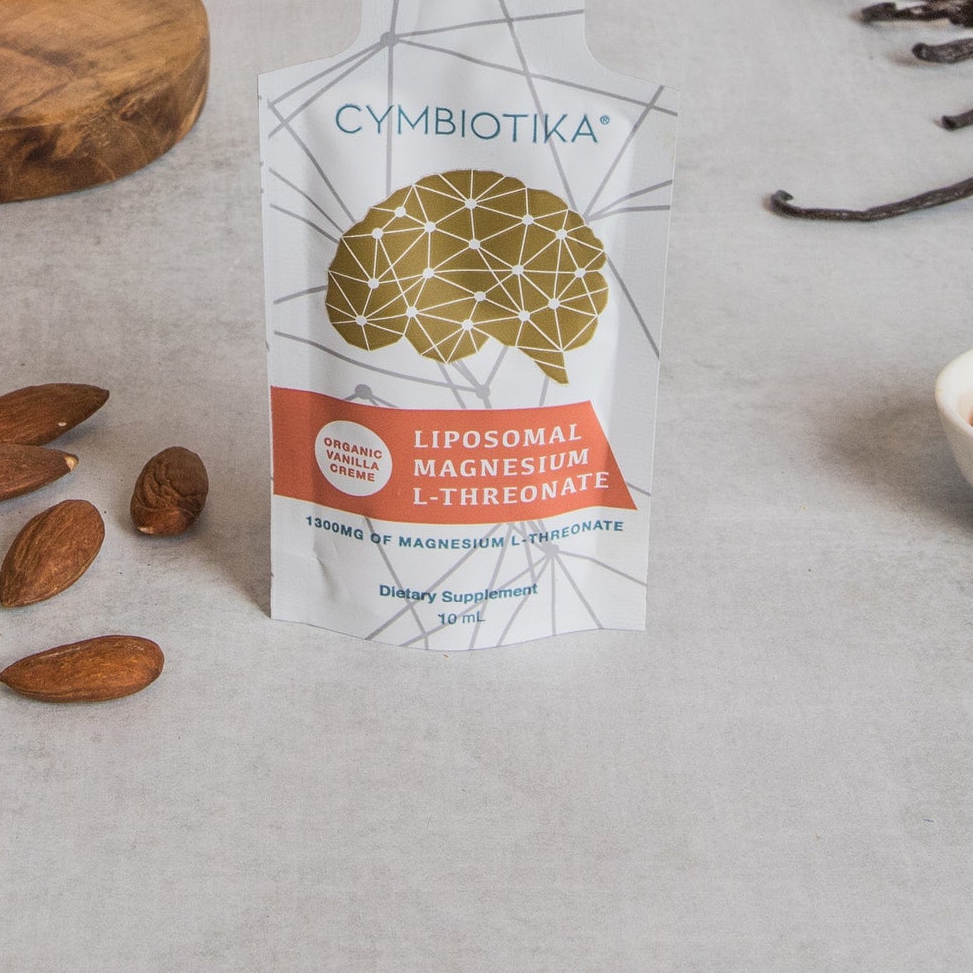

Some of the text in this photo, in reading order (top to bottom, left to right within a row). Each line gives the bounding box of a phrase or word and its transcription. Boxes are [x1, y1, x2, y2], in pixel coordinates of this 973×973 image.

[414, 423, 582, 449] LIPOSOMAL
[323, 437, 383, 460] ORGANIC
[326, 450, 380, 472] VANILLA
[330, 463, 376, 482] CREME
[413, 448, 589, 477] MAGNESIUM
[413, 471, 610, 506] L-THREONATE
[306, 515, 624, 550] 1300MG OF MAGNESIUM L-THREONATE
[379, 582, 539, 604] Dietary Supplement
[437, 611, 485, 626] 10 mL
